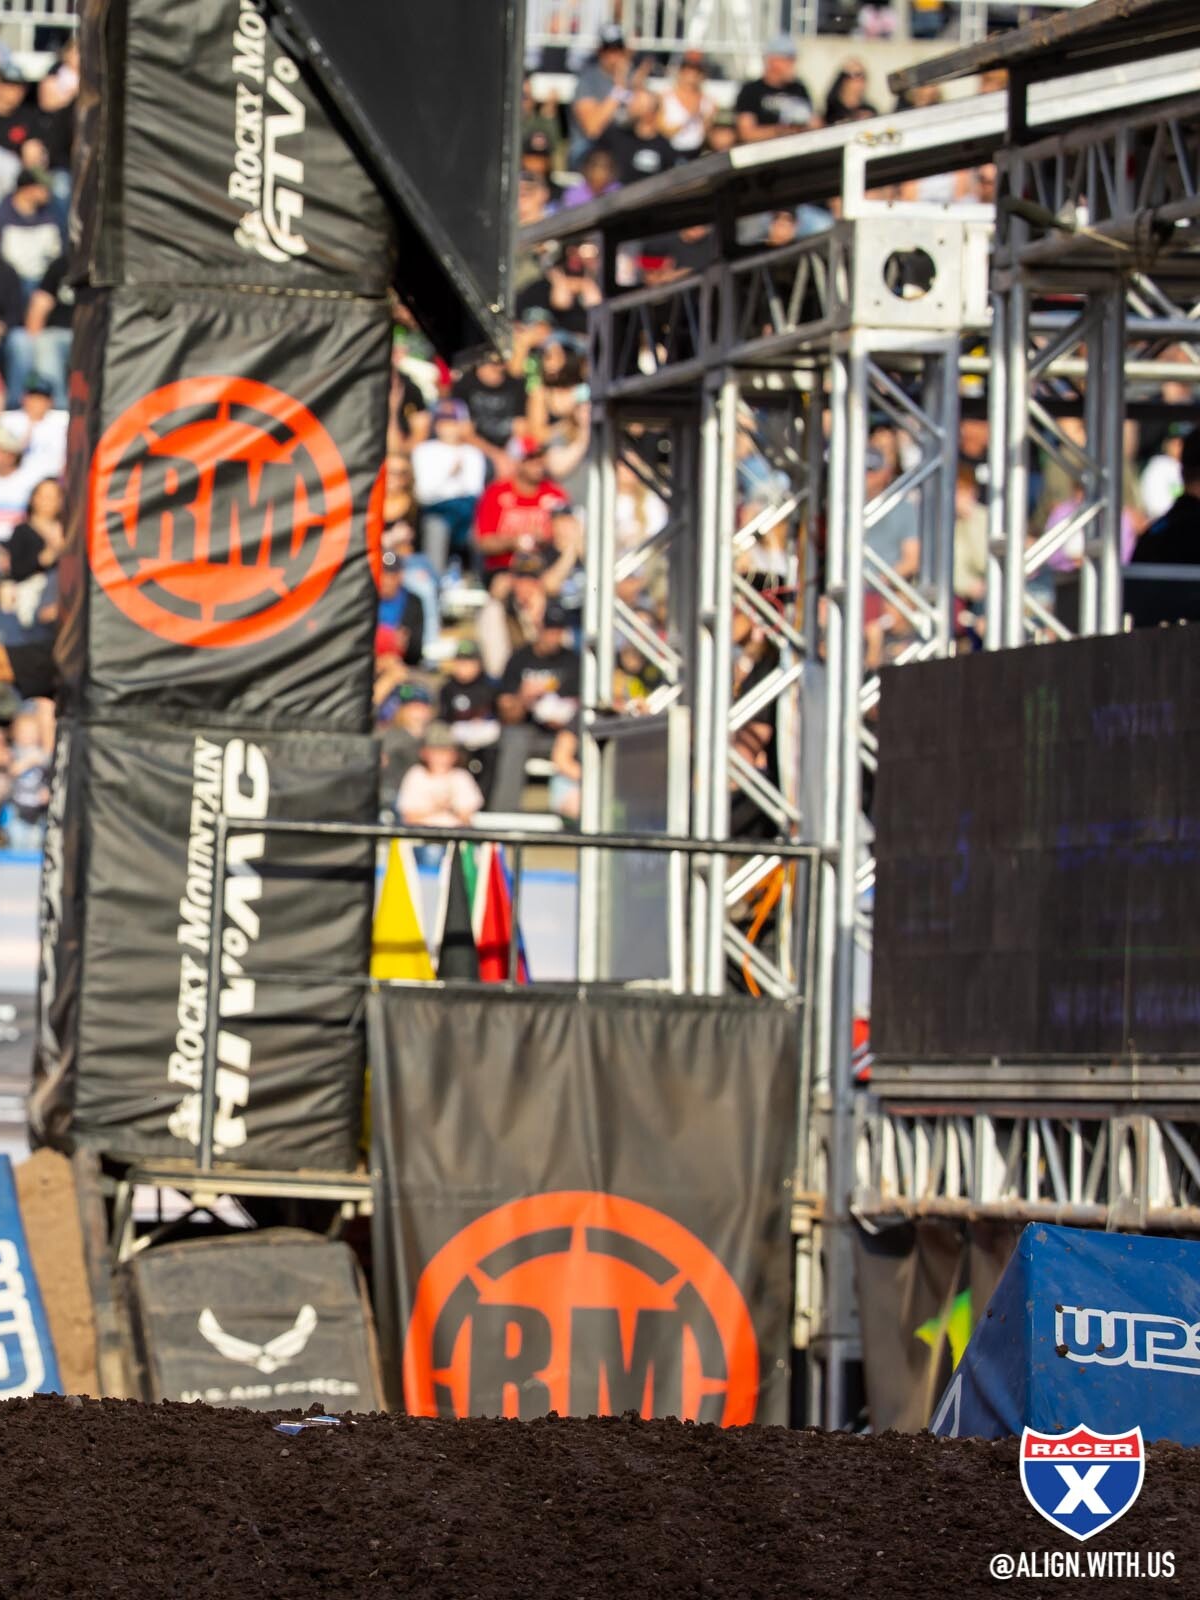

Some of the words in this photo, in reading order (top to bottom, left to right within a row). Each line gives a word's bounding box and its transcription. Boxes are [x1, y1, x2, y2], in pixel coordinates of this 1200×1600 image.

[228, 82, 263, 207] ROCKY
[136, 452, 298, 570] RM
[177, 735, 224, 954] MOUNTAIN
[167, 954, 208, 1091] ROCKY
[468, 1303, 685, 1424] RM
[1055, 1304, 1200, 1376] WP
